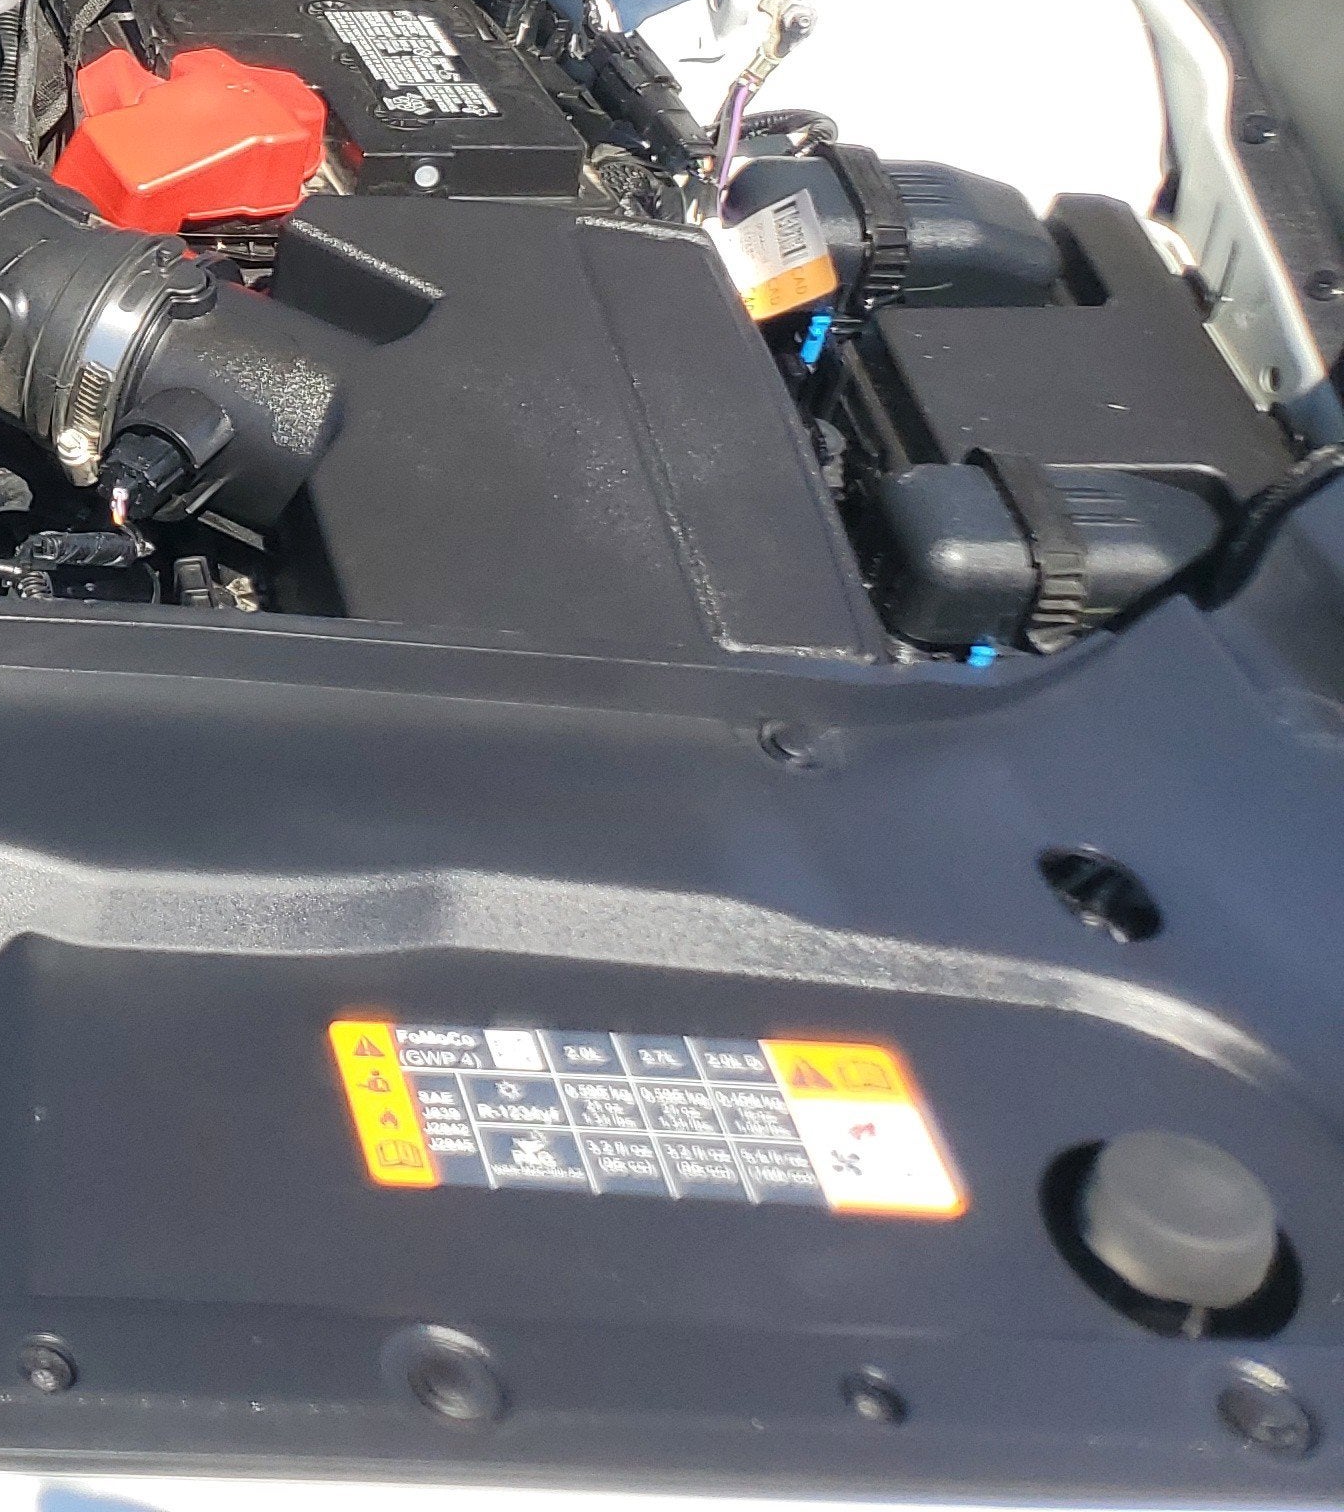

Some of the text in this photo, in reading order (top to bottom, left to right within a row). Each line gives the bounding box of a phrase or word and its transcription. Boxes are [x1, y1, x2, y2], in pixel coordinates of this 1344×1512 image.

[396, 1029, 476, 1047] FoMoCo
[400, 1049, 456, 1067] (GWP
[417, 1090, 455, 1105] SAE
[477, 1103, 560, 1125] R-1234yf
